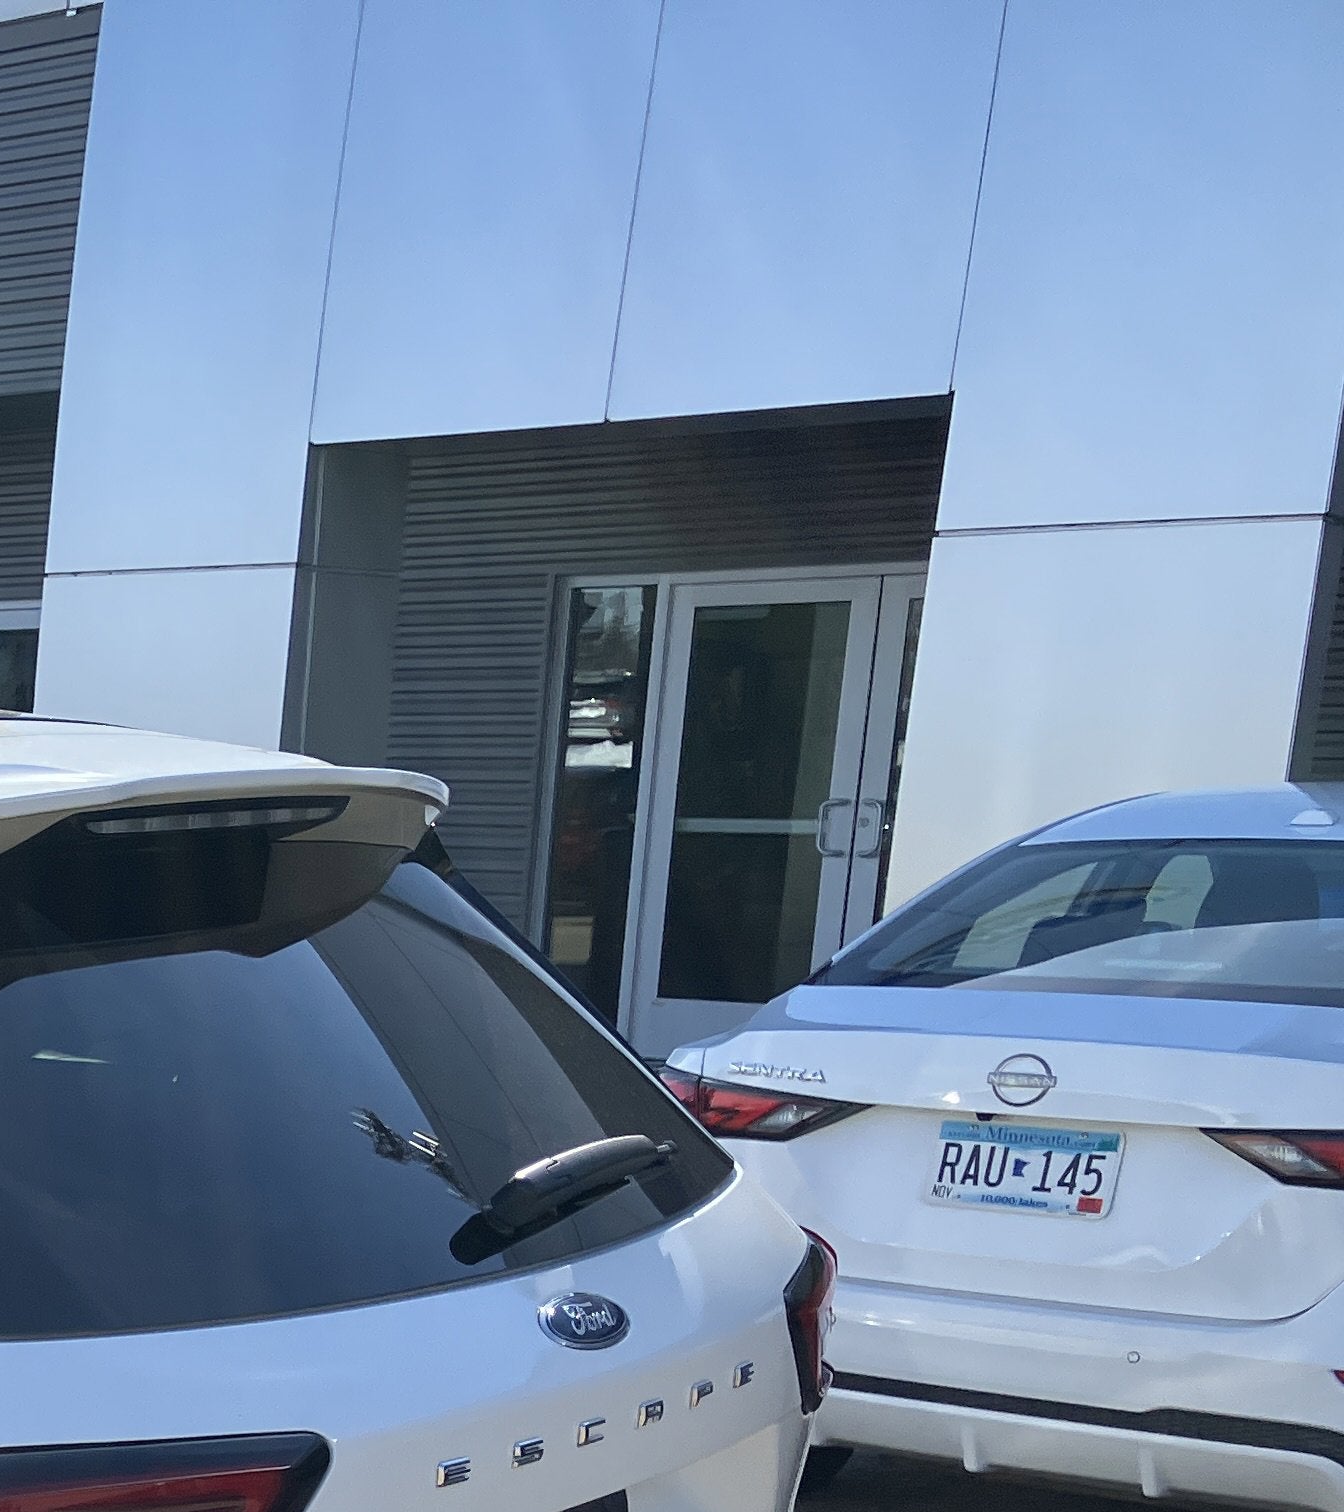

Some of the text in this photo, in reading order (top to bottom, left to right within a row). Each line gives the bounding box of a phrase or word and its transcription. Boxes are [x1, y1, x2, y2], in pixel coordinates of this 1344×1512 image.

[937, 1142, 1107, 1196] RAU 145
[563, 1301, 616, 1335] Ford
[435, 1360, 755, 1488] ESCAPE
